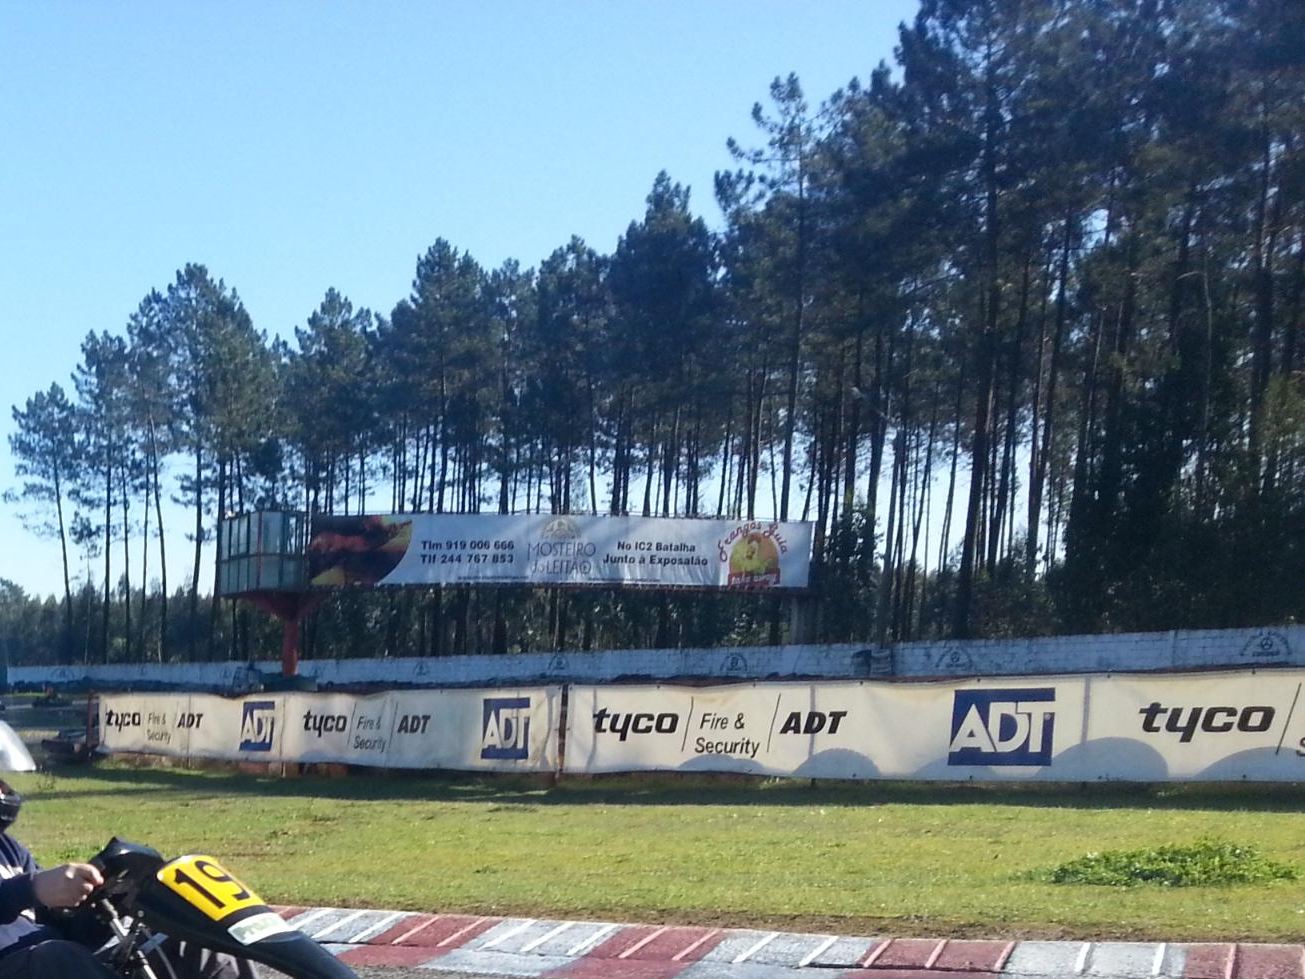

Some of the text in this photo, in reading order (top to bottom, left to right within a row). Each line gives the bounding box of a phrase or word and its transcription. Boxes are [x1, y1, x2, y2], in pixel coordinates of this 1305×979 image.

[446, 540, 467, 550] 919
[469, 540, 491, 550] 006
[494, 540, 514, 550] 666
[528, 542, 596, 560] MOSTEIRO
[617, 541, 696, 552] No IC2 Batalha
[441, 554, 462, 564] 244
[467, 554, 488, 564] 767
[603, 553, 636, 564] Junto
[106, 709, 141, 733] tyco
[148, 712, 161, 725] Fire
[177, 712, 203, 728] ADT
[241, 707, 273, 744] ADT
[303, 709, 347, 738] tyco
[356, 715, 375, 730] Fire
[397, 714, 431, 734] ADT
[482, 706, 530, 750] ADT
[593, 707, 679, 741] tyco
[699, 712, 745, 730] Fire &
[779, 711, 847, 734] ADT
[949, 701, 1055, 753] ADT
[1139, 702, 1276, 743] tyco
[147, 730, 171, 745] Security
[353, 735, 387, 753] Security
[694, 737, 760, 759] Security
[173, 860, 251, 909] 19
